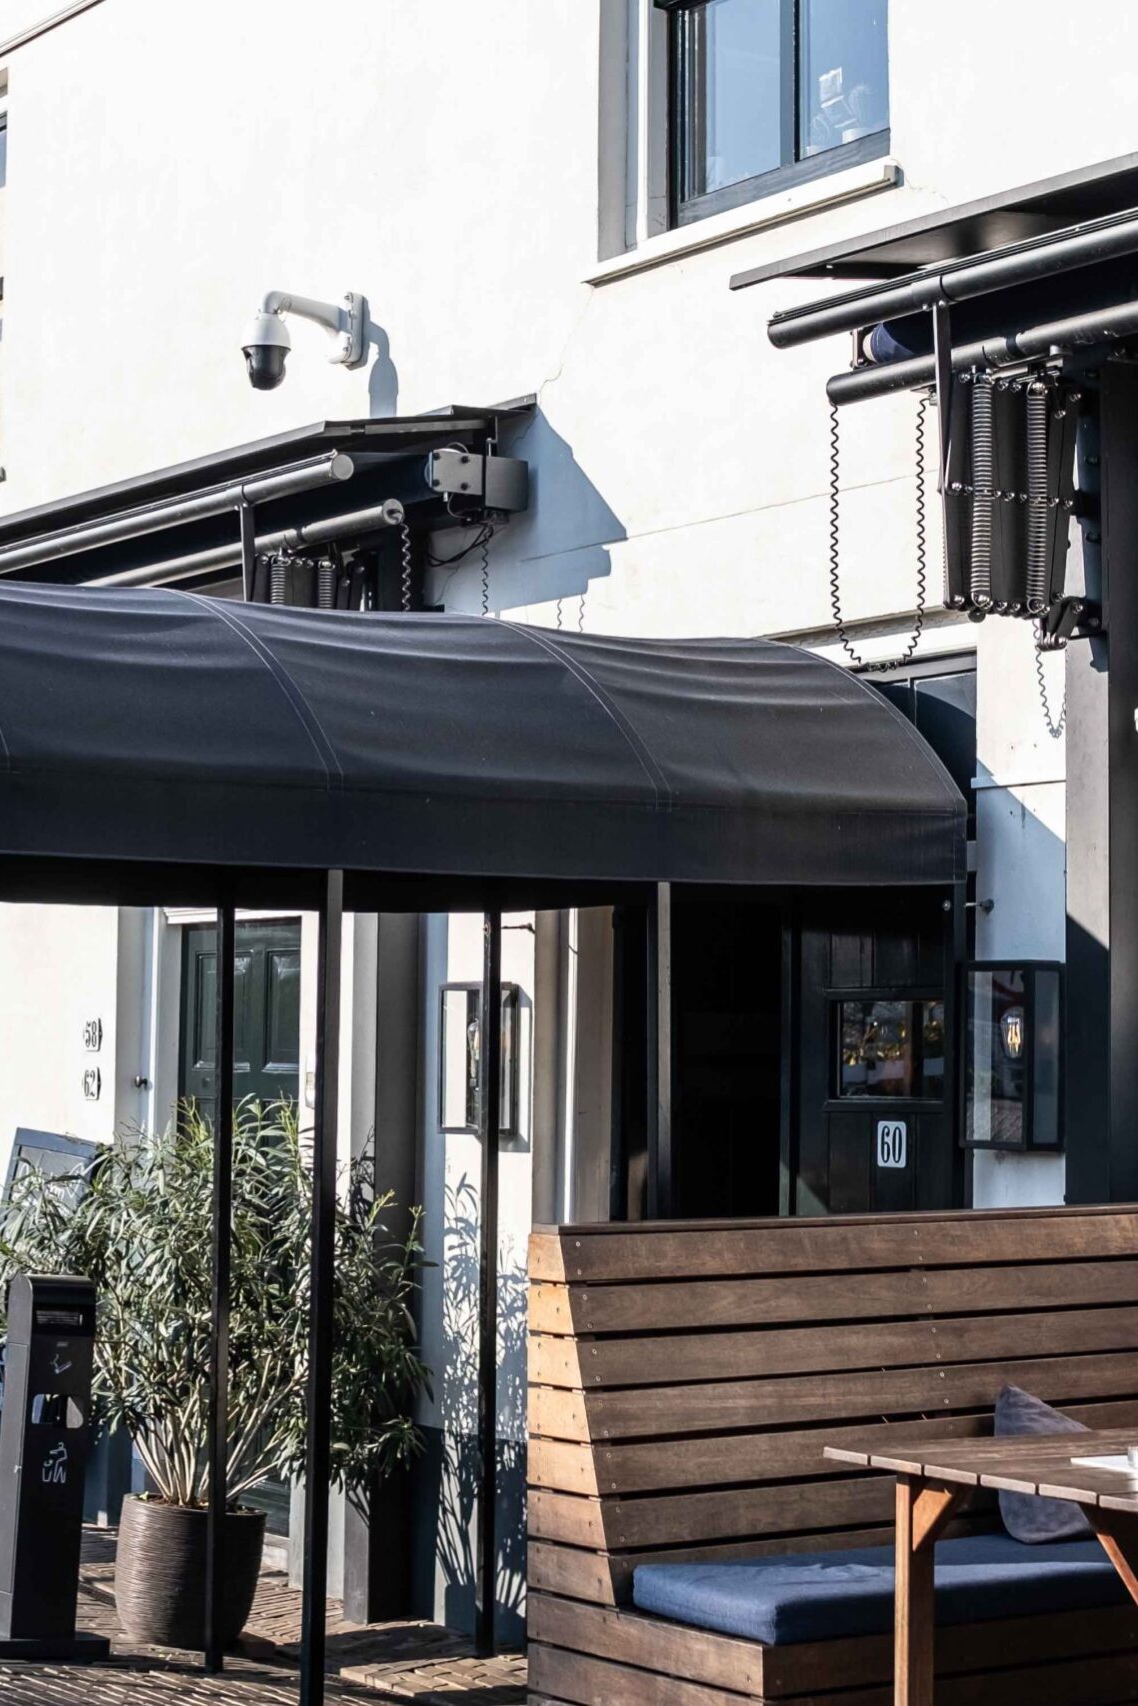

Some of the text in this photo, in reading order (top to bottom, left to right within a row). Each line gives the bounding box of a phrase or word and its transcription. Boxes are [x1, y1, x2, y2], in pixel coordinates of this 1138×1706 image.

[85, 1020, 97, 1048] 58
[84, 1069, 96, 1097] 62
[880, 1125, 903, 1164] 60
